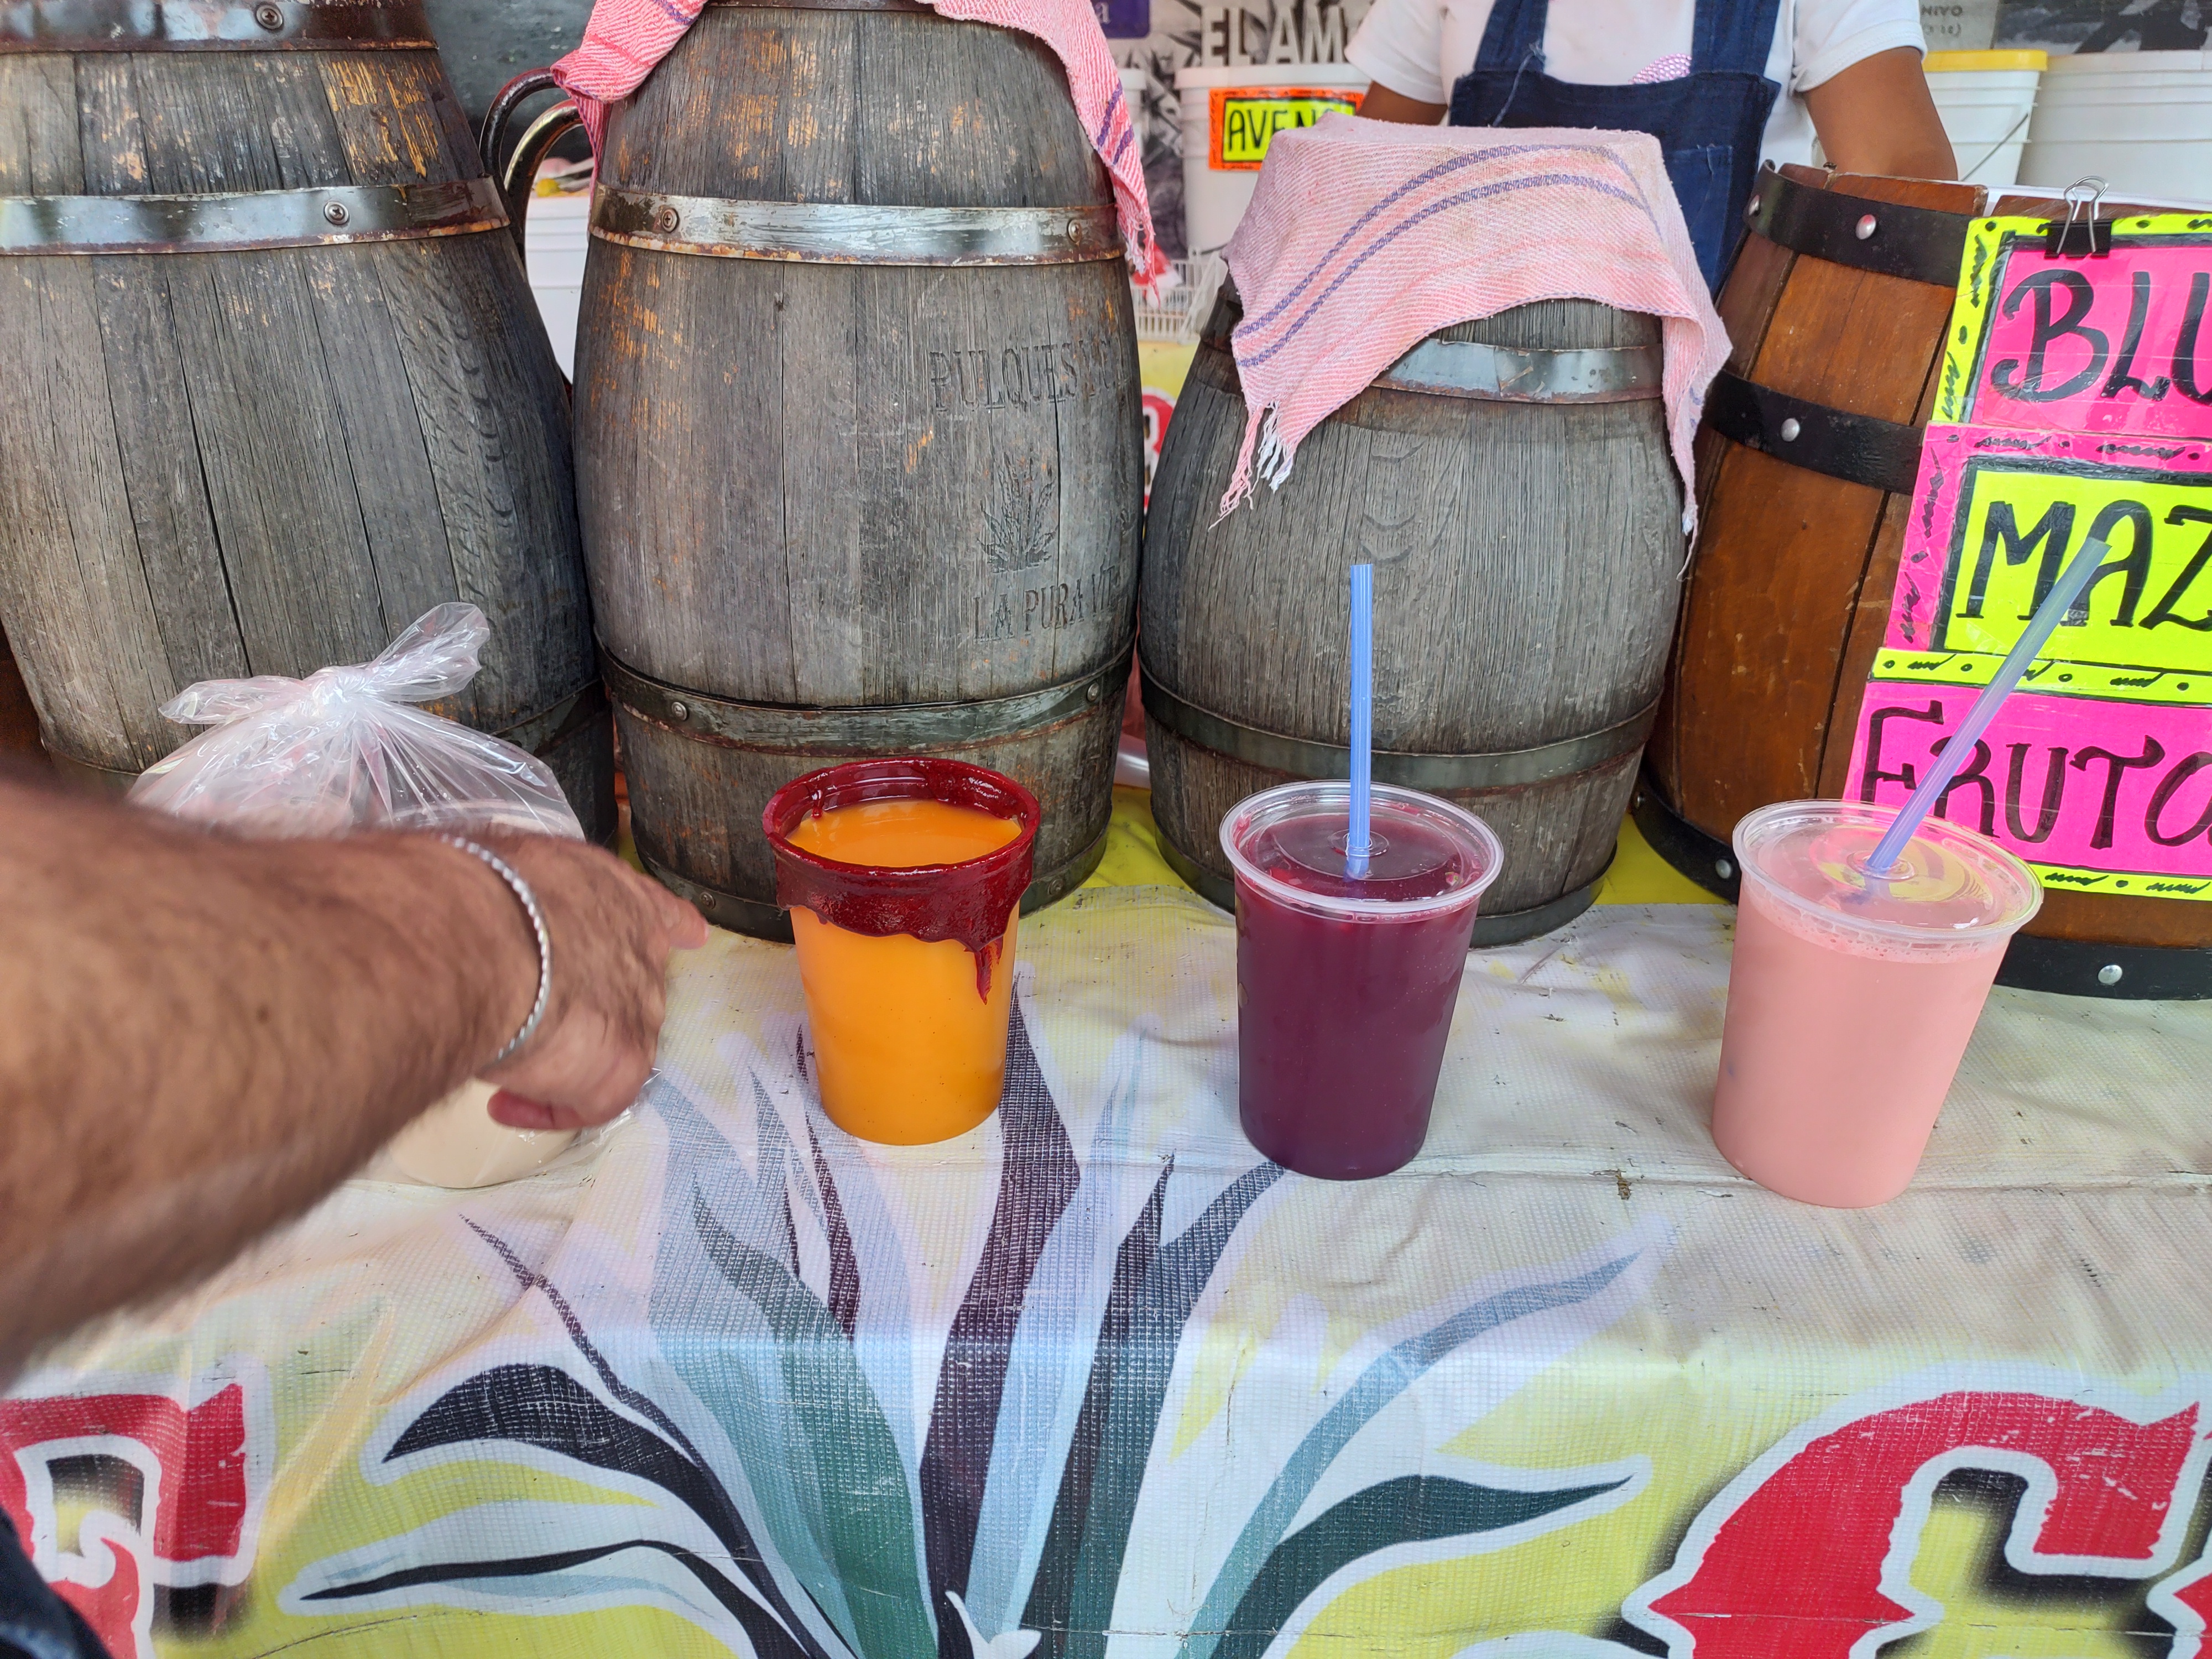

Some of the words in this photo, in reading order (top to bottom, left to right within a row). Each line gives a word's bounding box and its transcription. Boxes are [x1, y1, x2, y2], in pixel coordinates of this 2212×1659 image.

[1201, 4, 1255, 66] EL
[1228, 108, 1335, 152] AVEN
[973, 593, 1015, 643] LA
[1859, 700, 2212, 851] FRUTO
